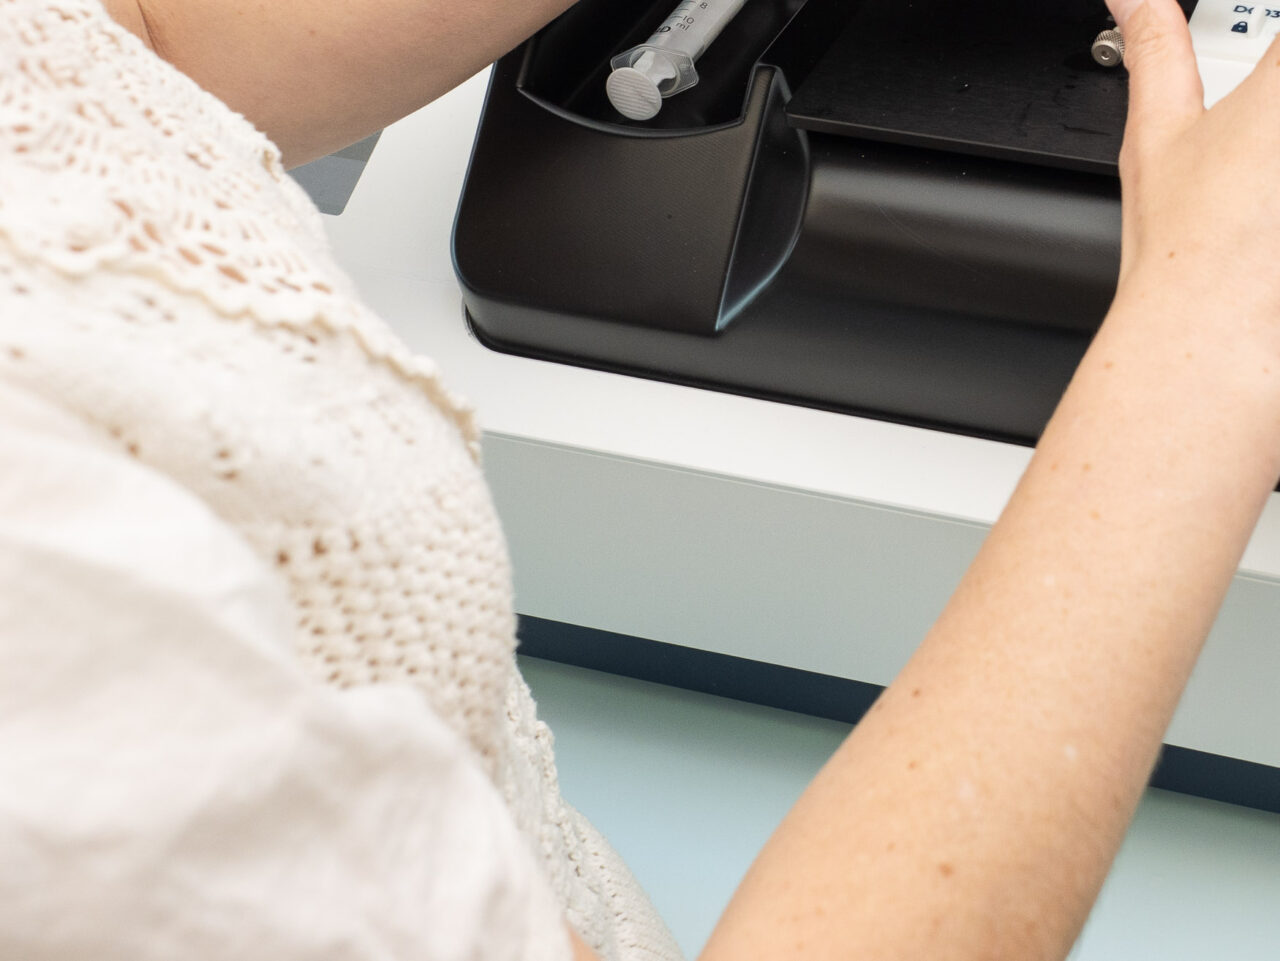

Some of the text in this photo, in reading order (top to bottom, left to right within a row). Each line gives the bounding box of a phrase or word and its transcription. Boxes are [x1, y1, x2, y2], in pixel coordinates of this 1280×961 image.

[699, 1, 708, 10] 8
[682, 15, 695, 25] 10
[675, 22, 690, 31] ml
